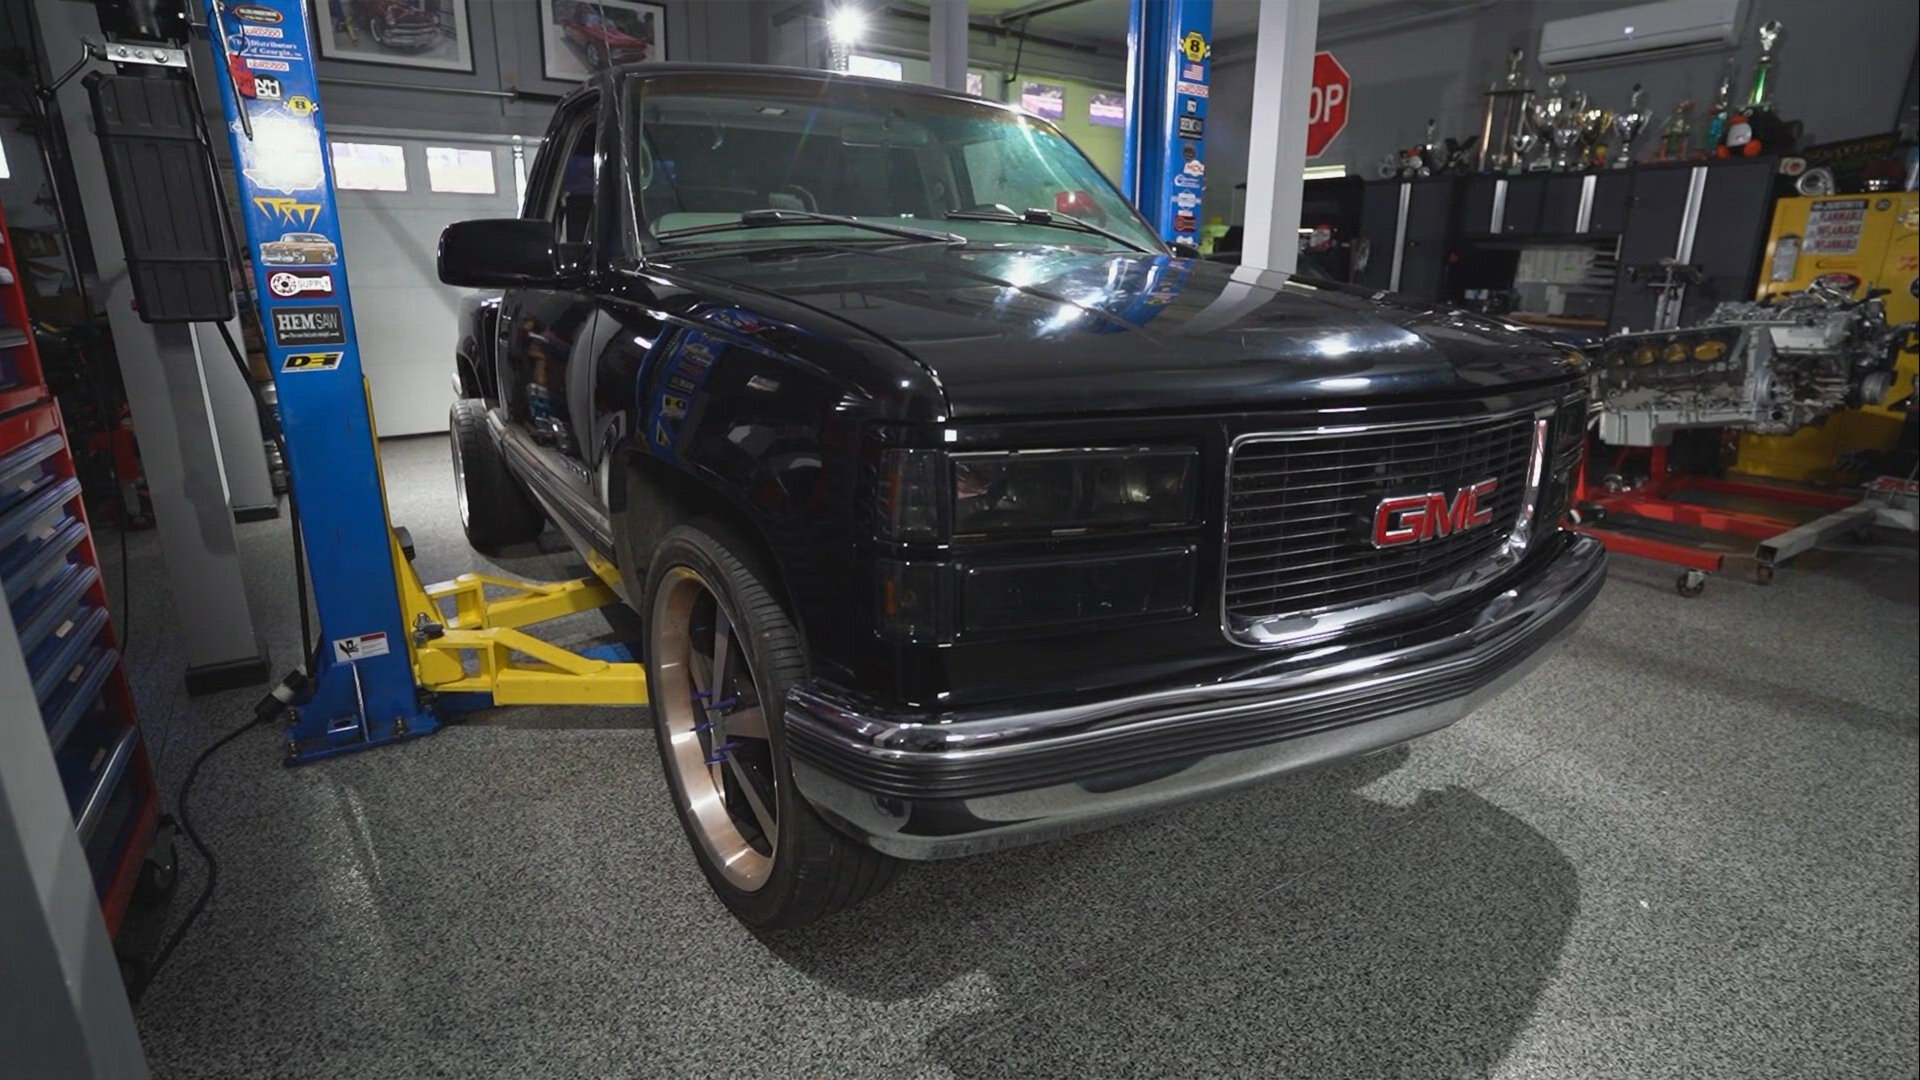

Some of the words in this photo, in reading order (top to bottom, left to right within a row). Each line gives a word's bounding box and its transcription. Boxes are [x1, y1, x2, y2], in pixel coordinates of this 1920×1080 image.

[251, 40, 297, 49] Distributors
[1190, 39, 1200, 53] 8
[294, 100, 306, 110] 8
[1308, 83, 1345, 125] OP
[297, 279, 331, 288] SUPPLY
[1371, 477, 1498, 549] GMC
